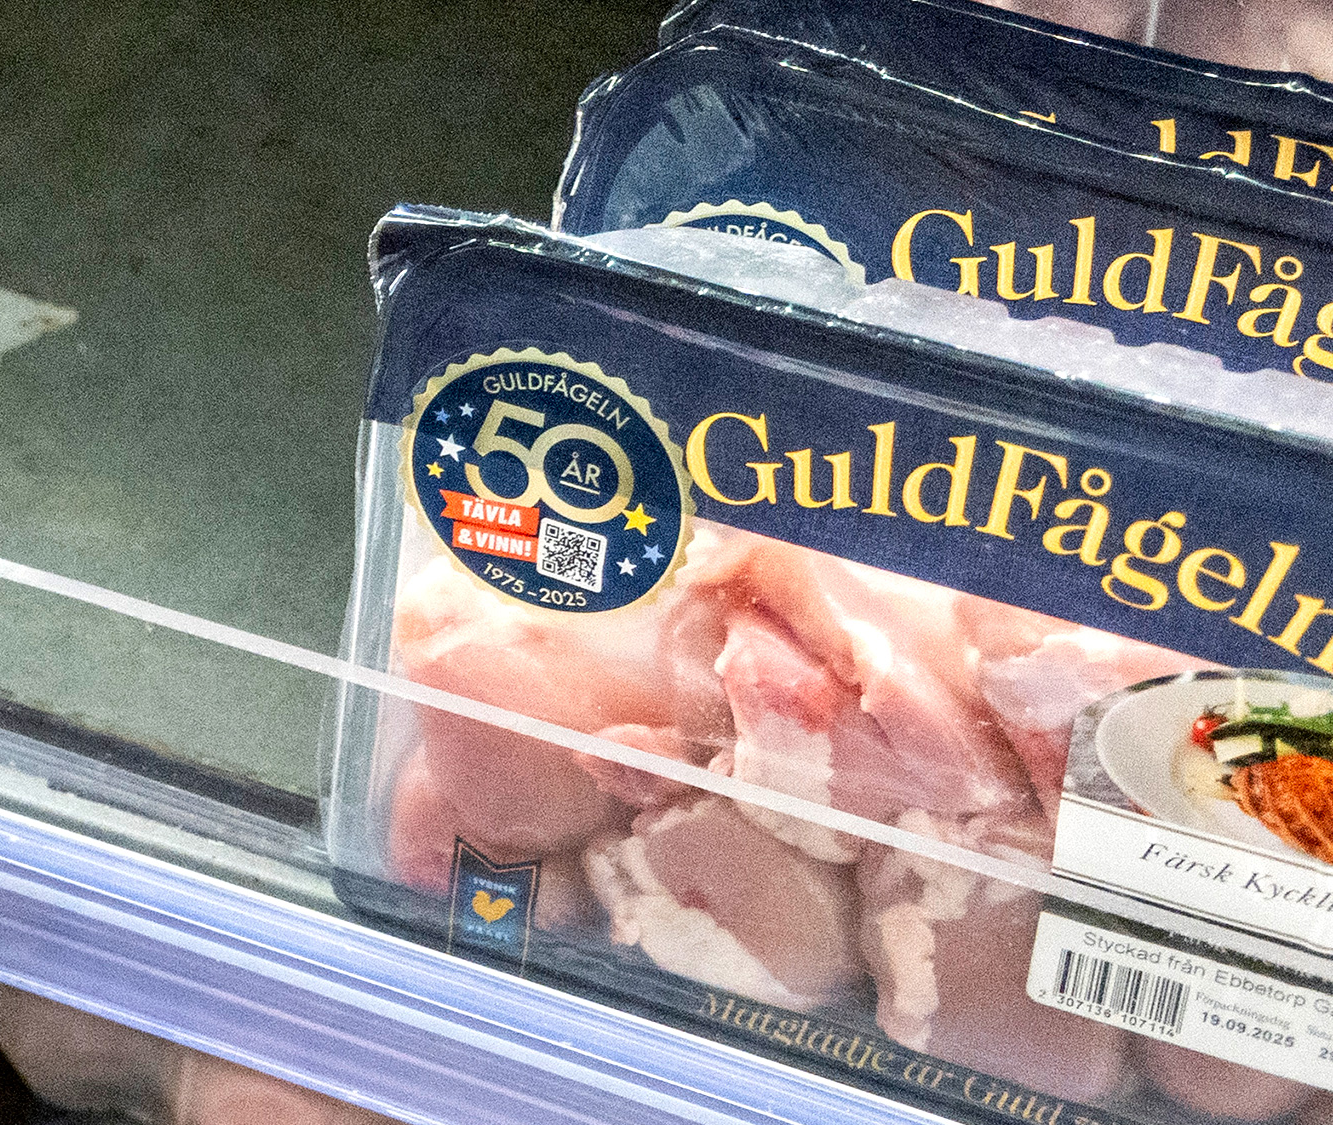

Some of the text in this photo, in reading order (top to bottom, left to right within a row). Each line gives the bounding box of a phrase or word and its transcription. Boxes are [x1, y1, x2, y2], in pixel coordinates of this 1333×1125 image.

[482, 371, 631, 432] GULDFÅGELN
[464, 399, 635, 525] 50
[559, 451, 602, 489] ÅR
[461, 499, 522, 527] TÄVLA
[1138, 841, 1234, 883] Färsk
[1082, 931, 1162, 966] Styckad
[1168, 954, 1207, 978] från
[1214, 969, 1308, 1009] Ebbetorp
[1200, 1010, 1296, 1048] 19.09.2025
